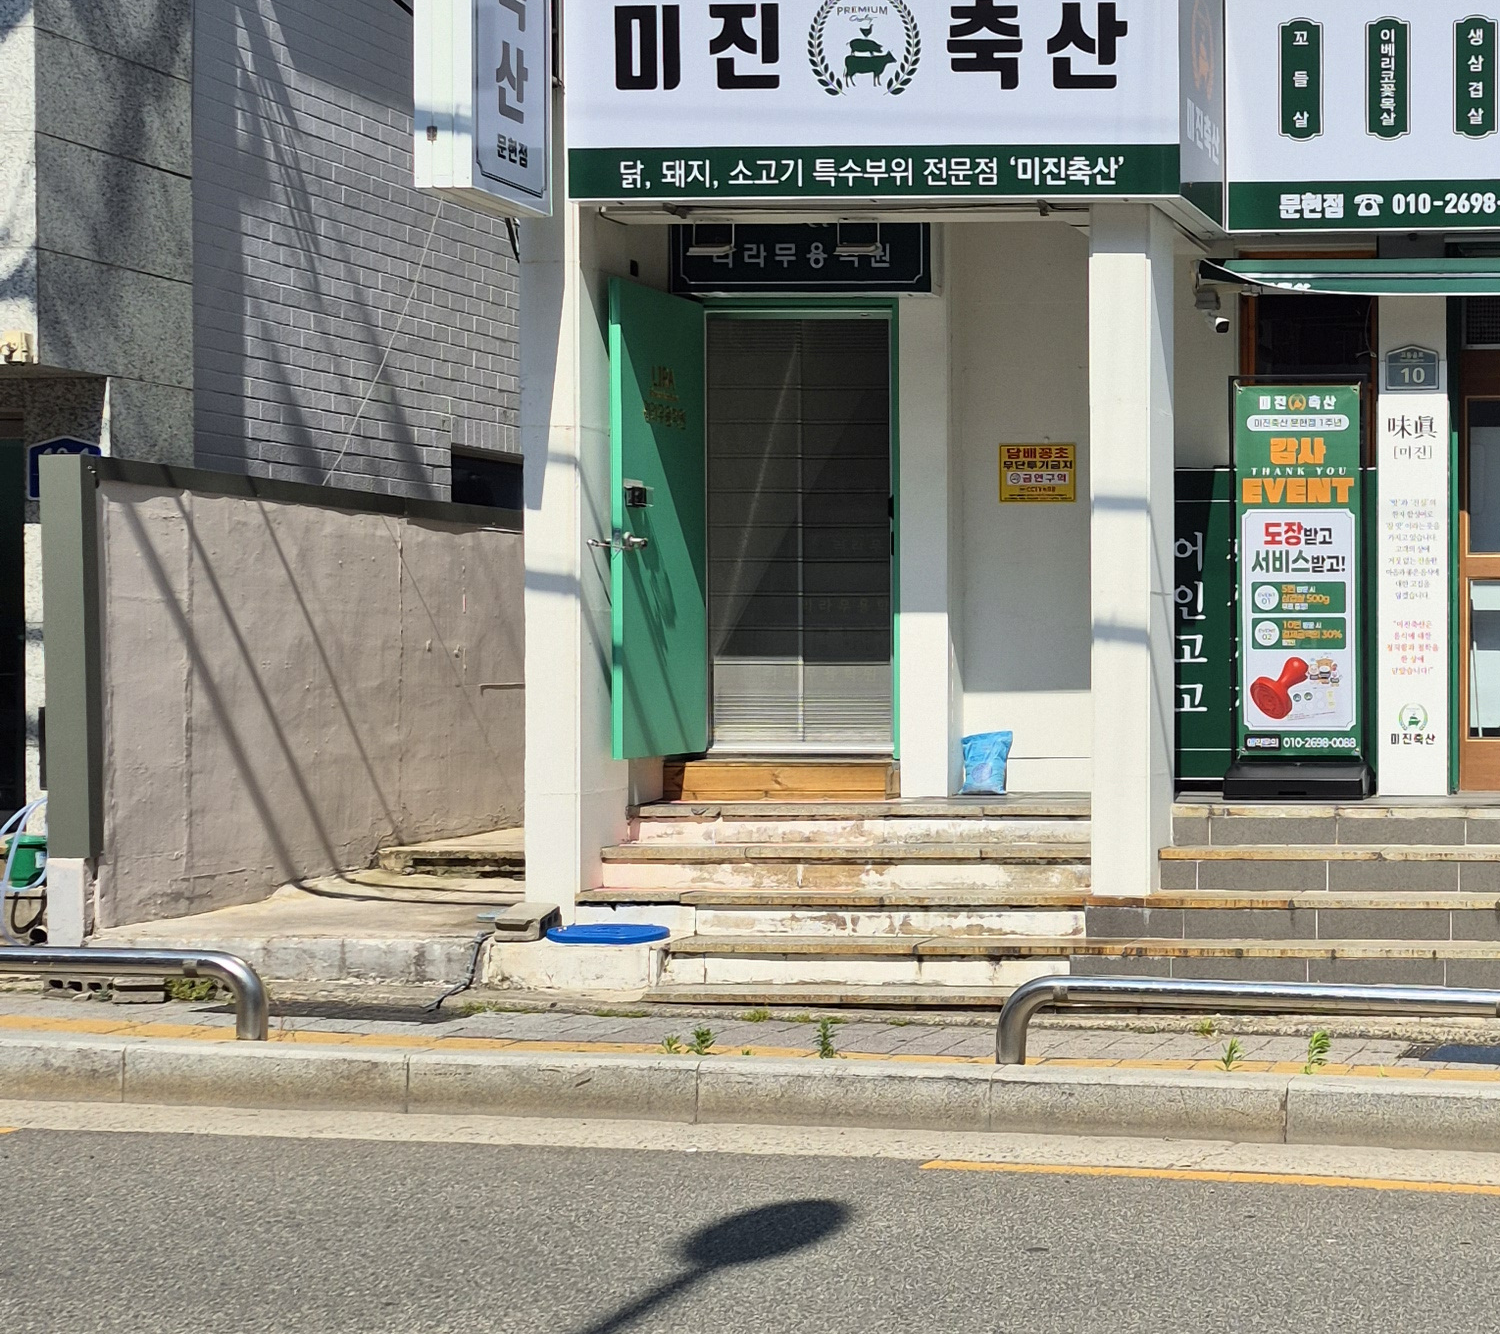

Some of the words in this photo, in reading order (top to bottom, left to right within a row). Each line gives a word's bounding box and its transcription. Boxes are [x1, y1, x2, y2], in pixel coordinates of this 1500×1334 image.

[837, 6, 888, 16] PREMIUM
[614, 3, 780, 91] 미진
[1292, 30, 1310, 129] 꼬들살
[1380, 28, 1397, 127] 이베리코꽃목살
[1467, 27, 1484, 126] 생삼겹살
[497, 133, 528, 168] 문현점
[619, 160, 652, 189] 닭,
[661, 160, 719, 189] 돼지,
[728, 158, 803, 187] 소고기
[812, 158, 914, 187] 특수부위
[923, 157, 998, 186] 전문점
[1279, 193, 1344, 219] 문현점
[1400, 367, 1425, 384] 10
[1259, 395, 1287, 410] 미진
[1006, 447, 1070, 459] 담배꽁초
[1270, 437, 1327, 464] 감사
[1003, 460, 1073, 469] 무단투기금지
[1251, 467, 1305, 475] THANK
[1315, 466, 1347, 475] YOU
[1242, 477, 1354, 504] EVENT
[1263, 522, 1333, 546] 도장받고
[1251, 549, 1345, 573] 서비스받고!
[1306, 593, 1330, 605] 500g
[1283, 737, 1356, 748] 010-2698-0088
[1391, 733, 1436, 745] 미진축산
